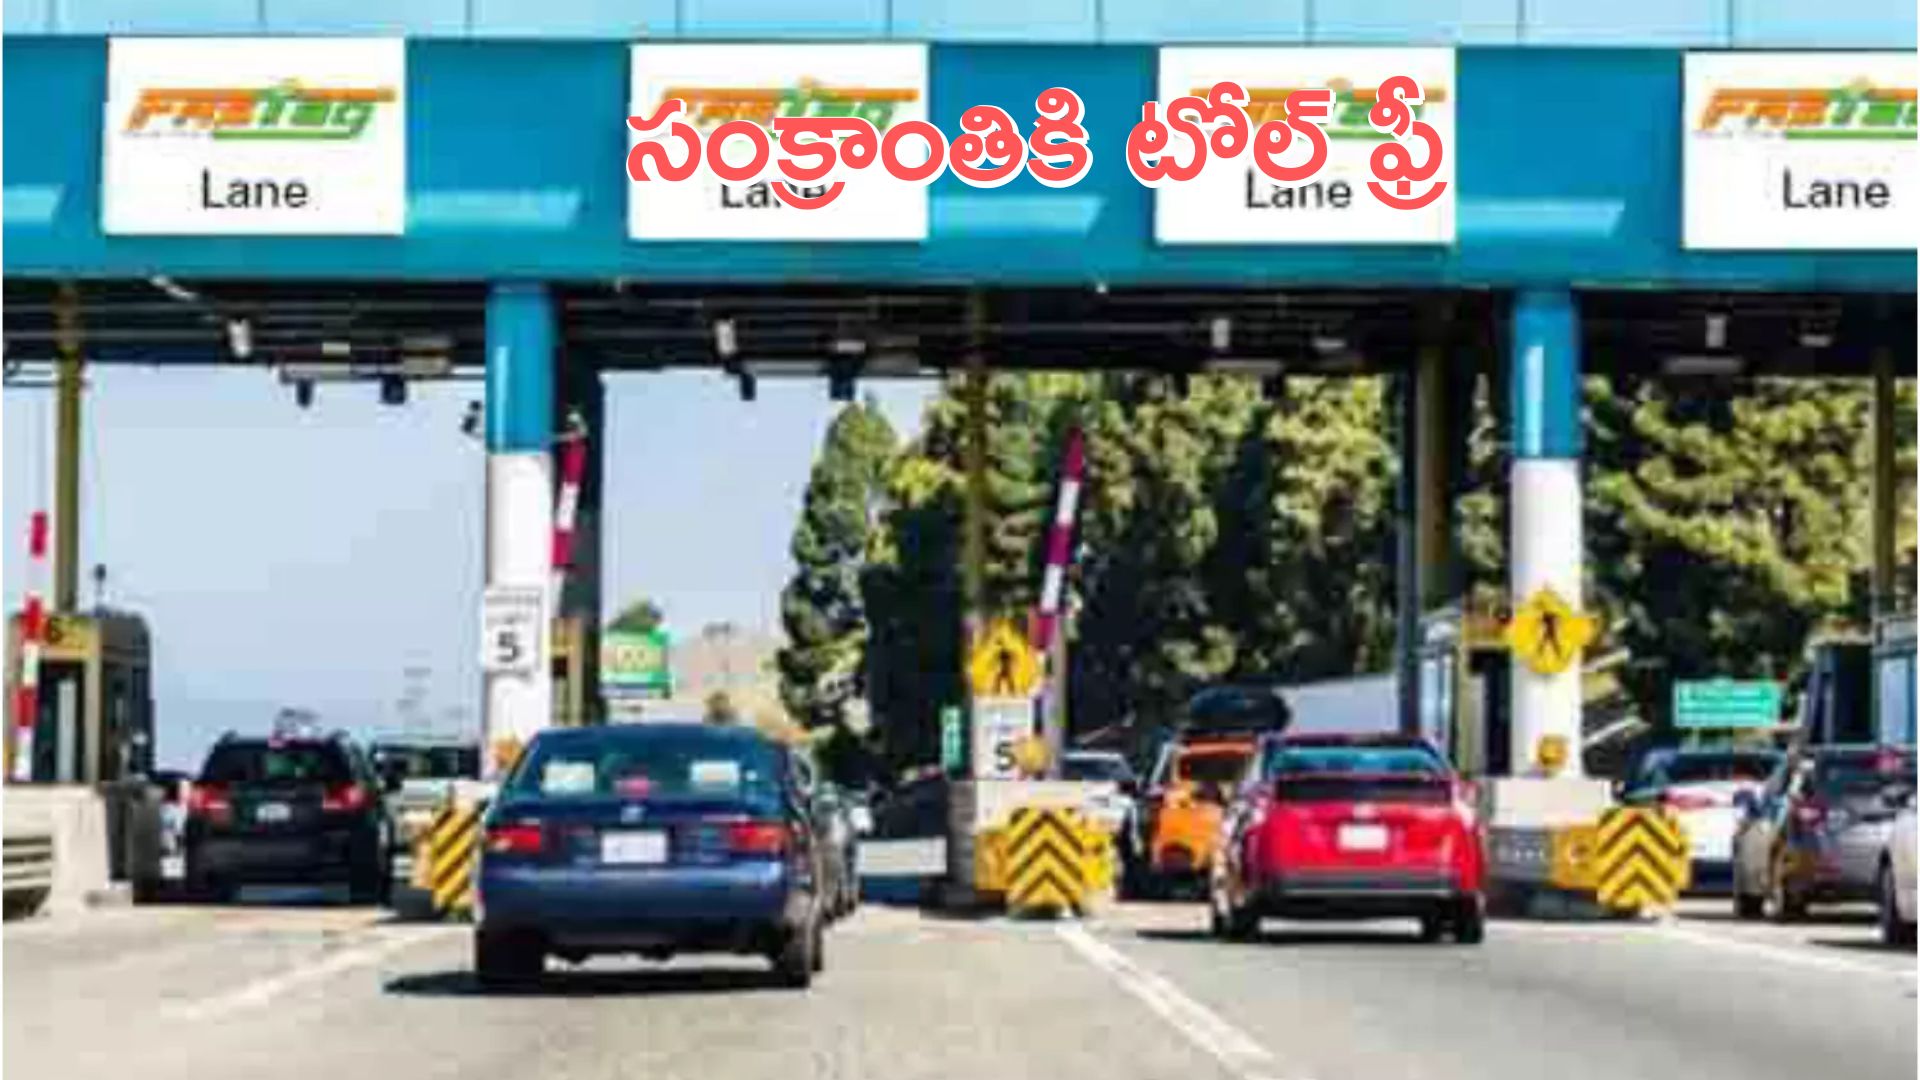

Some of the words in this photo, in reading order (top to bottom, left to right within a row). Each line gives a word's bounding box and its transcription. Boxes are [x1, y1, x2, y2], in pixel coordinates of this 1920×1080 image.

[201, 168, 309, 209] Lane
[1245, 168, 1353, 209] Lane
[1782, 167, 1891, 209] Lane
[497, 631, 521, 663] 5
[994, 741, 1017, 772] 5
